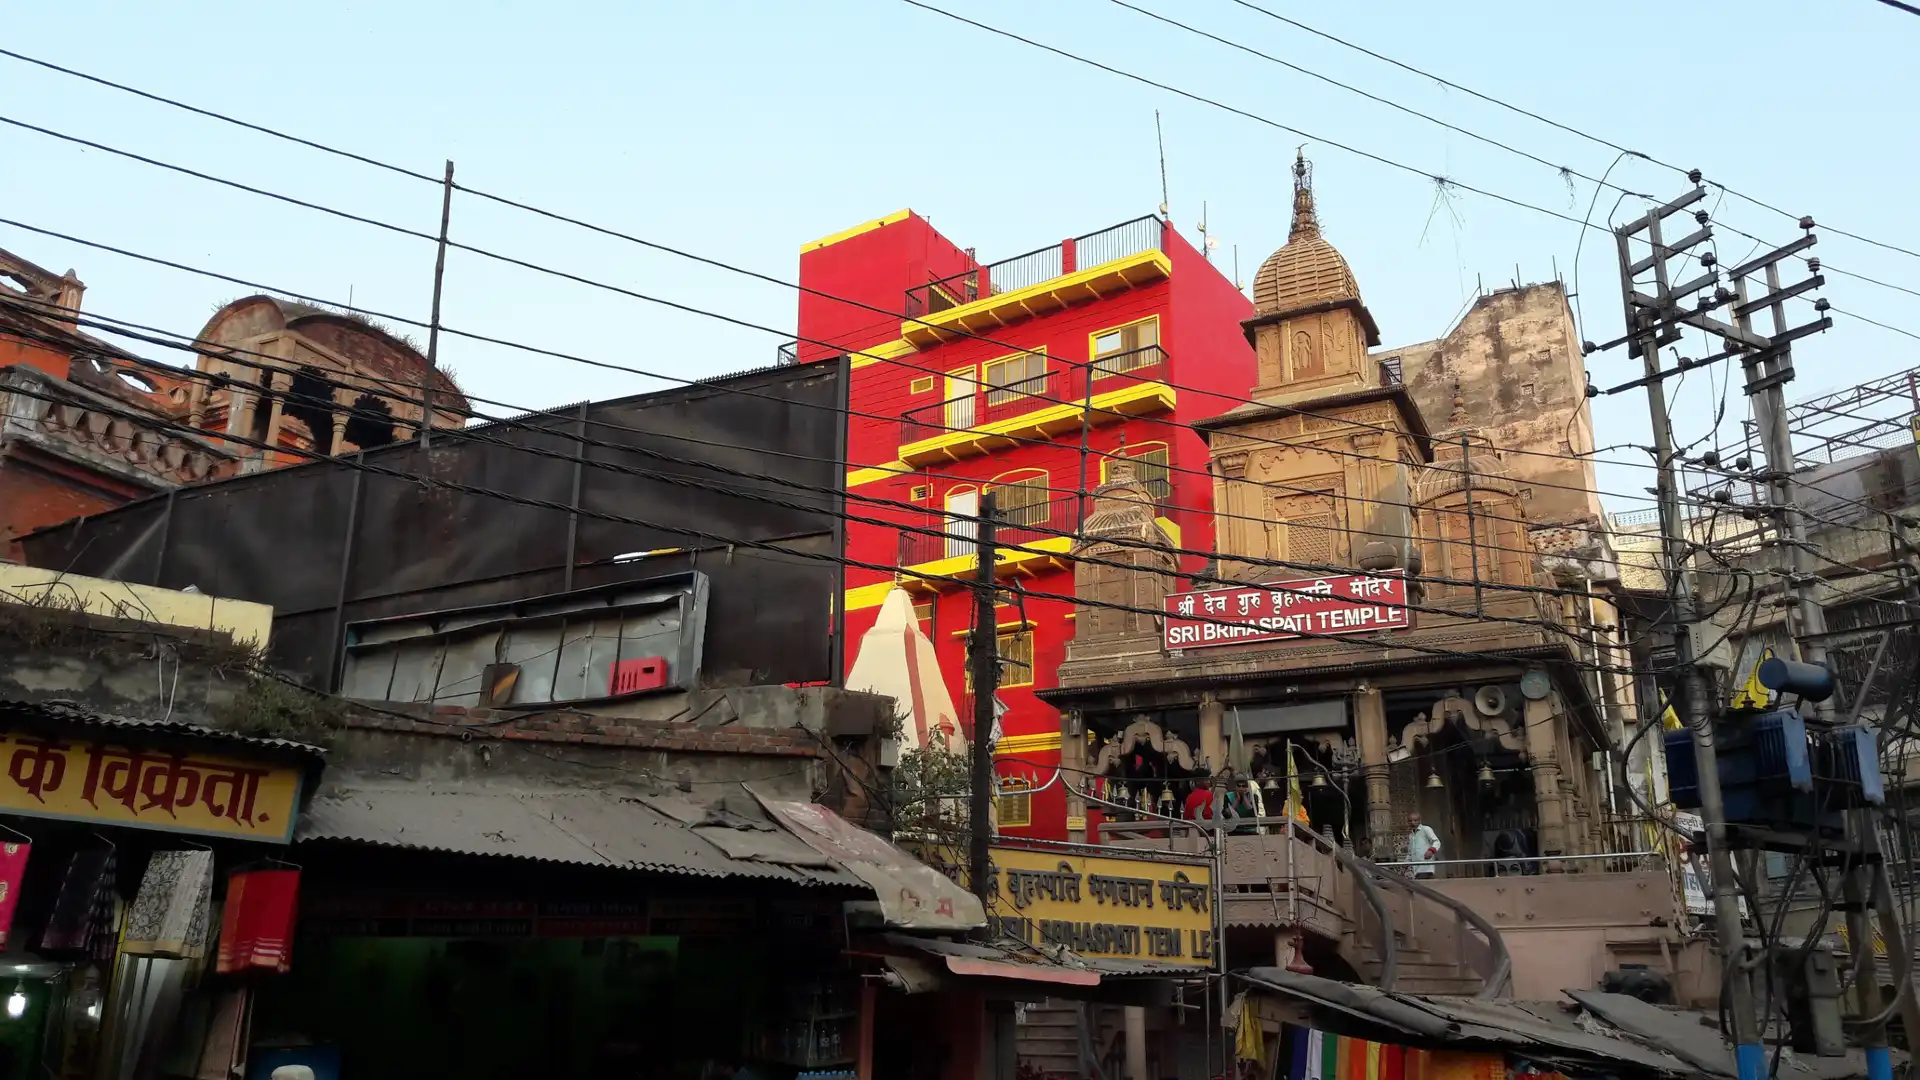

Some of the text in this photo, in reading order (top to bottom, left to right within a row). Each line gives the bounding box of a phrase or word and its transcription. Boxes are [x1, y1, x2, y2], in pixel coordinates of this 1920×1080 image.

[1177, 594, 1195, 615] श्री
[1203, 592, 1228, 615] देव
[1237, 591, 1261, 616] गुरु
[1350, 577, 1394, 598] मंदिर
[1168, 606, 1402, 644] SRI BRIHASPATI TEMPLE
[1088, 873, 1154, 908] भगवान
[1039, 918, 1141, 956] BRIHASPATI
